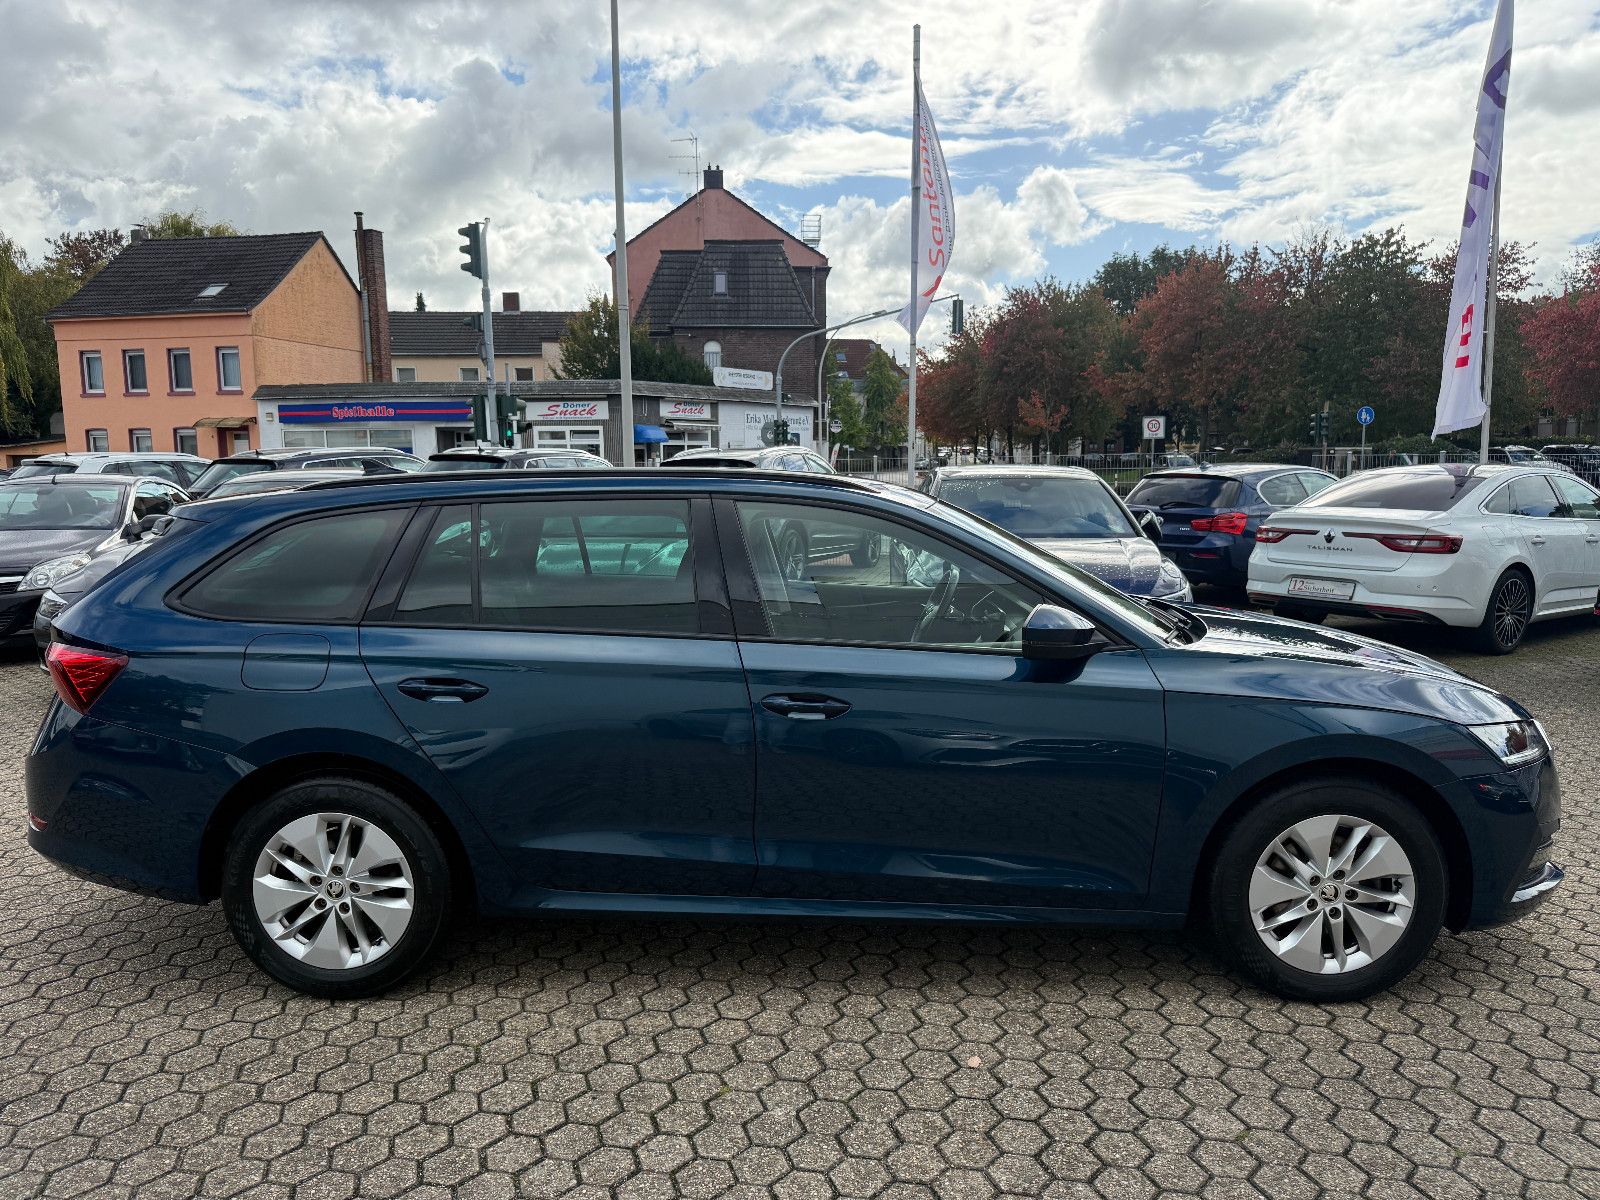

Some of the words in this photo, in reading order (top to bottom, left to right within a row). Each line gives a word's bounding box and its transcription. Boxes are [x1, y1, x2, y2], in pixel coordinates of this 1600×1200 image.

[332, 406, 394, 419] Spielhalle
[537, 404, 598, 417] Snack
[667, 402, 705, 415] Snack
[746, 413, 761, 424] Erika
[1291, 579, 1305, 591] 12
